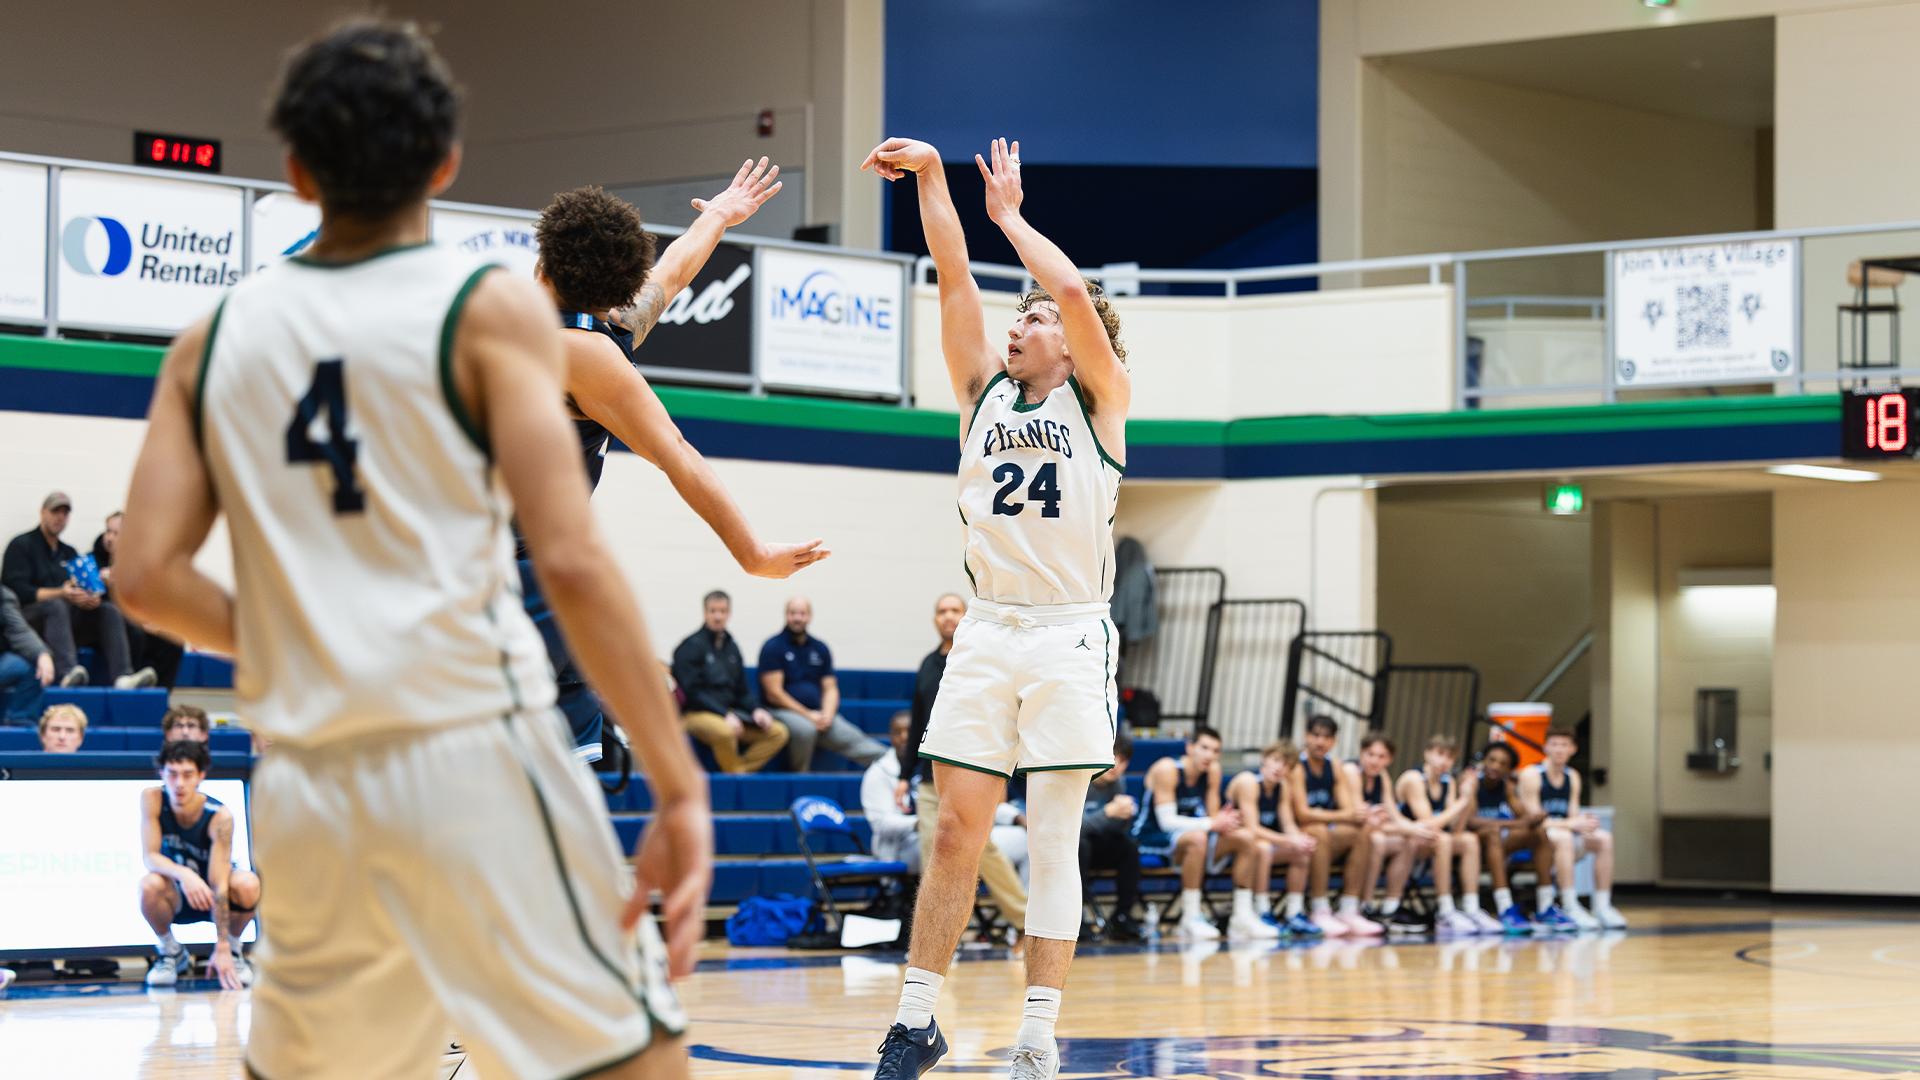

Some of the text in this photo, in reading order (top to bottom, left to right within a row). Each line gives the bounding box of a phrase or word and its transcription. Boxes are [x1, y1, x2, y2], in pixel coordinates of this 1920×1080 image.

[141, 223, 232, 256] United
[140, 254, 240, 287] Rentals
[657, 262, 752, 326] ad
[286, 358, 366, 513] 4
[1866, 393, 1907, 452] 18
[992, 462, 1062, 519] 24
